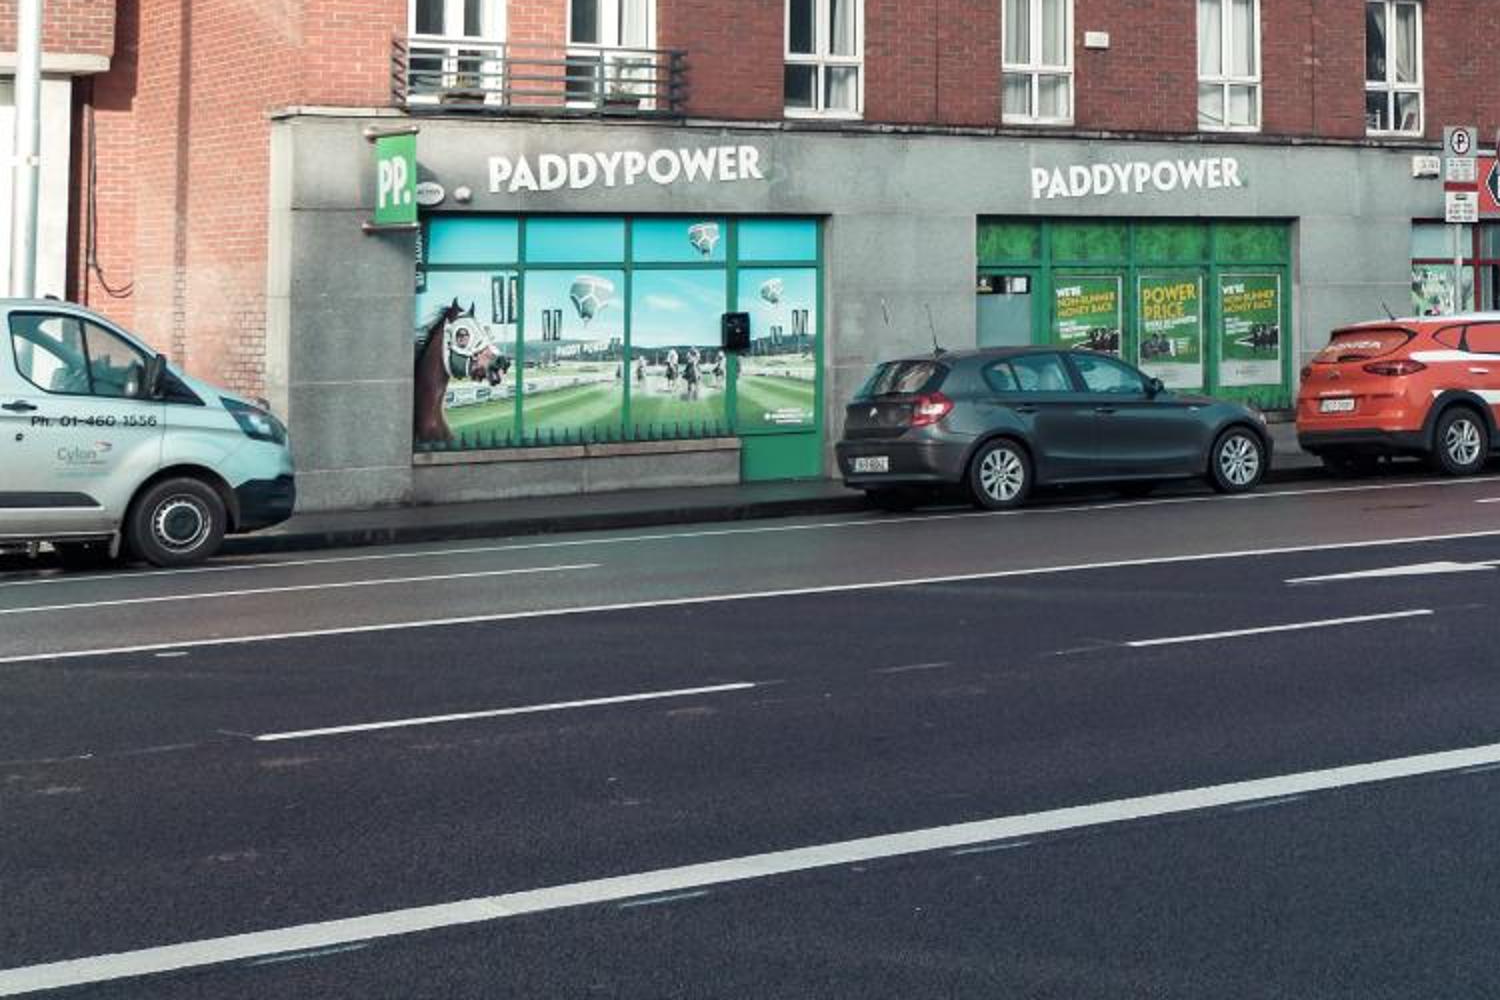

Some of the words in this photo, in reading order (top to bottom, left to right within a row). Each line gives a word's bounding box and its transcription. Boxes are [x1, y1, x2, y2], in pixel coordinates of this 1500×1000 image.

[378, 155, 411, 208] PP.
[488, 146, 763, 193] PADDYPOWER
[1031, 157, 1242, 199] PADDYPOWER
[1143, 283, 1197, 305] POWER
[1144, 301, 1184, 319] PRICE
[60, 416, 116, 427] 01-460
